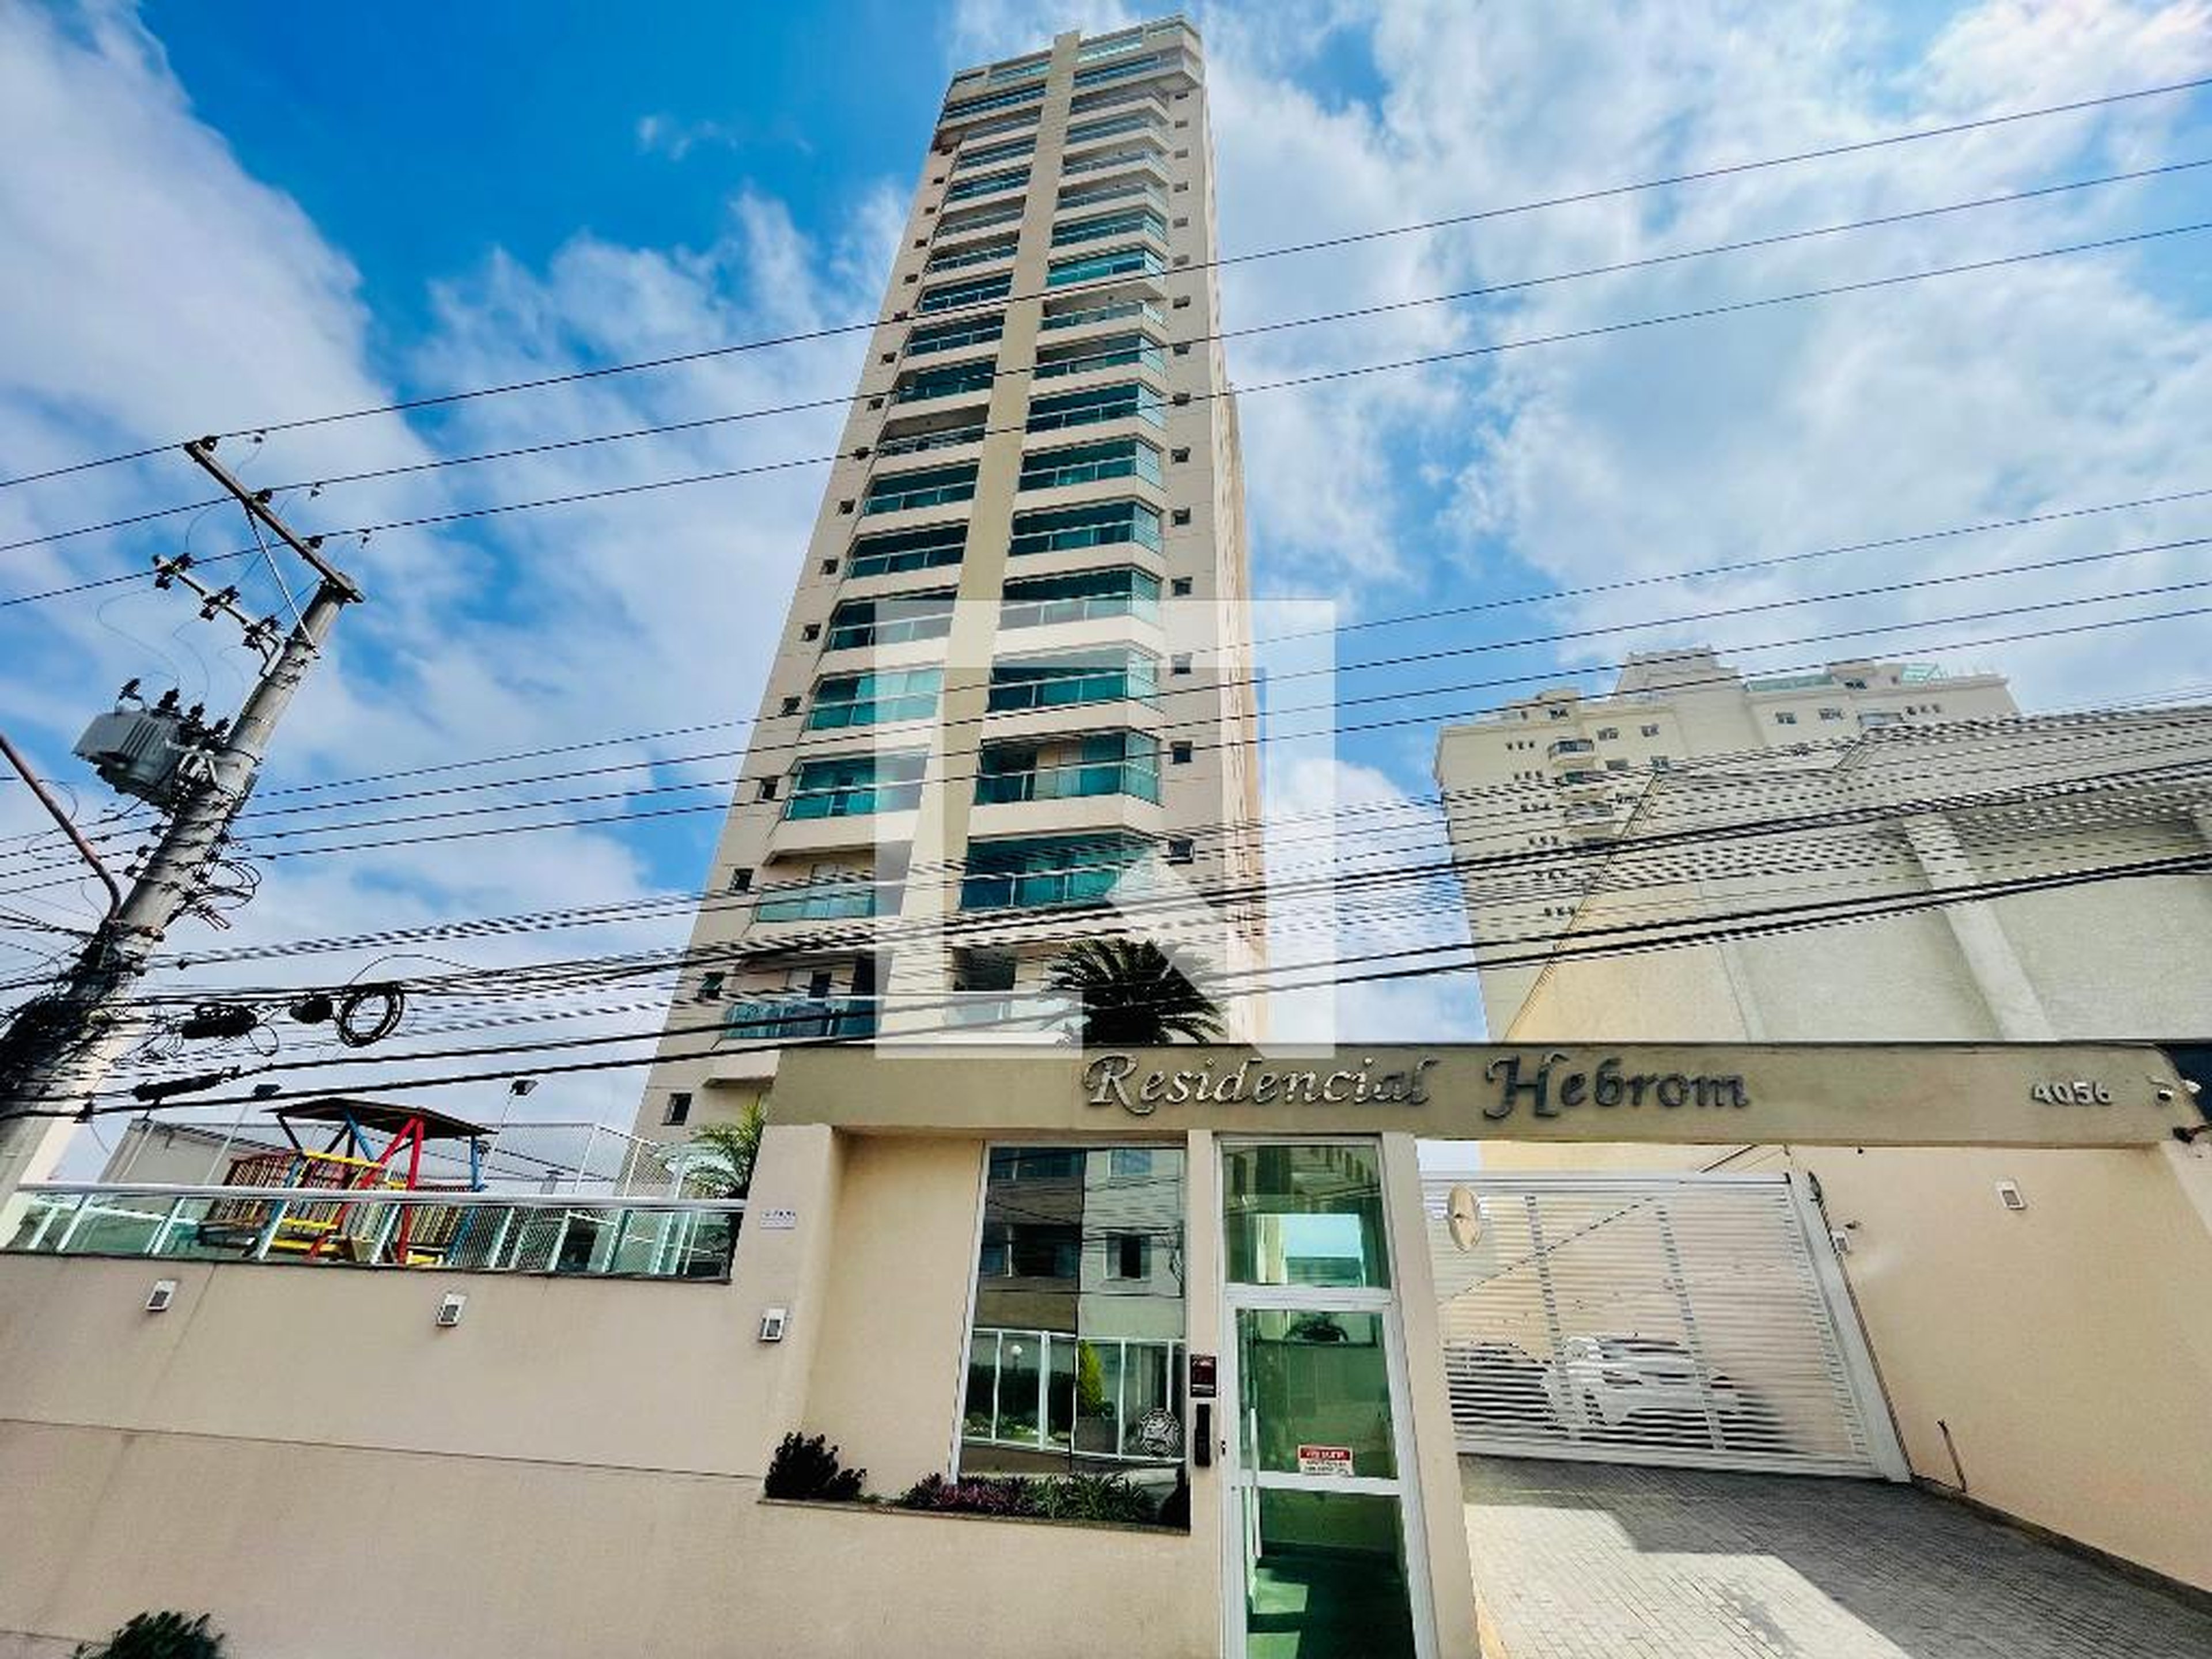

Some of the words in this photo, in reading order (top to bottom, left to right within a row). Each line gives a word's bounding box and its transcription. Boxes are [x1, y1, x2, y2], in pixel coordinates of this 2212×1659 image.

[1082, 1054, 1438, 1115] Residencial
[1484, 1052, 1749, 1119] Hebrom
[2032, 1080, 2112, 1106] 4056
